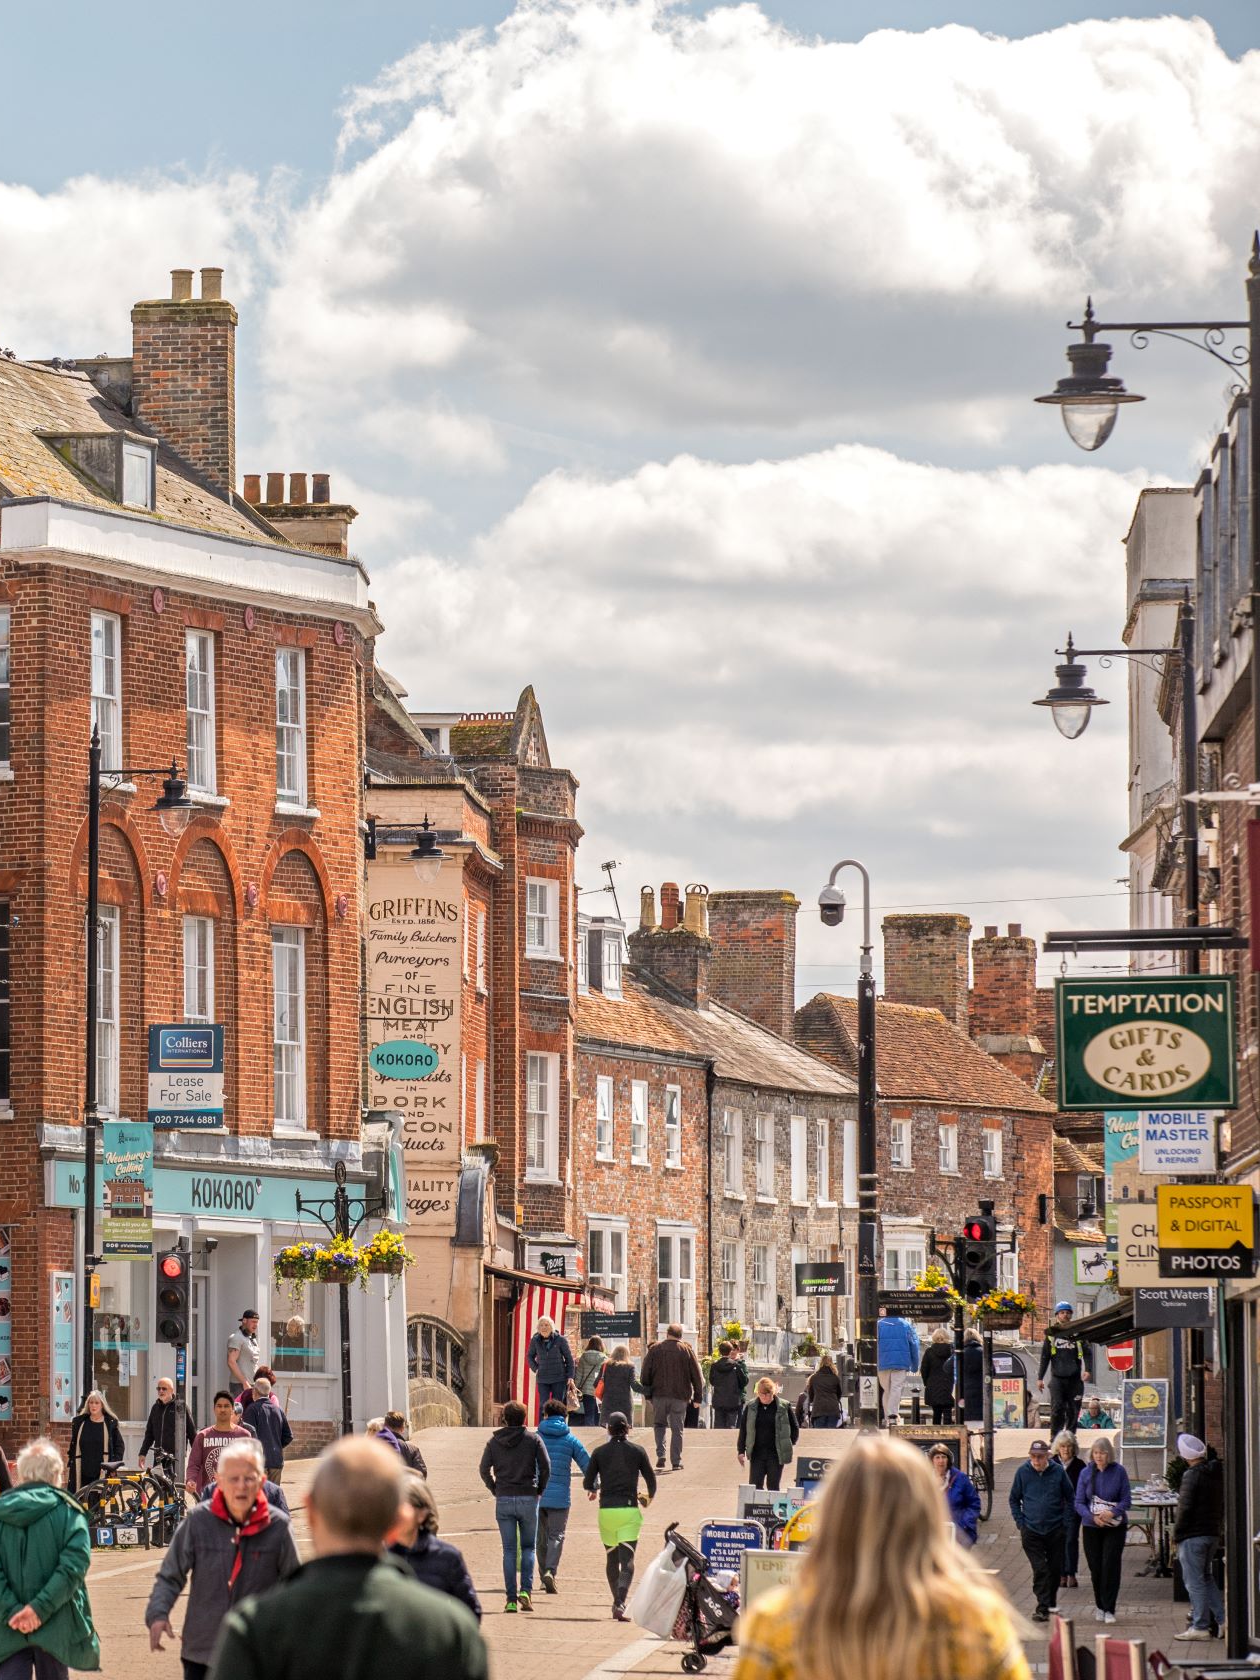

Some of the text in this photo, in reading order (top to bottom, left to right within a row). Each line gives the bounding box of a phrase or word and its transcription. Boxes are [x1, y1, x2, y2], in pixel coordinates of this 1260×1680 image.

[369, 898, 458, 921] GRIFFINS
[369, 930, 457, 944] Family Butchers
[375, 951, 450, 968] Purveyors
[404, 972, 419, 980] OF
[385, 984, 437, 994] FINE
[370, 997, 454, 1016] ENGLISH
[1067, 993, 1224, 1015] TEMPTATION
[386, 1020, 439, 1032] MEAT
[165, 1036, 208, 1048] Colliers
[1108, 1027, 1183, 1050] GIFTS
[376, 1053, 433, 1066] KOKORO
[1135, 1048, 1156, 1067] &
[168, 1075, 204, 1087] Lease
[1103, 1064, 1191, 1091] CARDS
[160, 1089, 212, 1101] For Sale
[373, 1095, 447, 1109] PORK
[155, 1115, 216, 1124] 020 7344 6881
[1148, 1113, 1207, 1125] MOBILE
[403, 1121, 453, 1134] CON
[1146, 1129, 1209, 1141] MASTER
[403, 1137, 446, 1151] ducts
[105, 1151, 151, 1165] Newbury's
[68, 1174, 81, 1194] No
[191, 1177, 256, 1211] KOKORO
[1169, 1196, 1242, 1209] PASSPORT
[1170, 1220, 1181, 1232] &
[1185, 1219, 1242, 1232] DIGITAL
[1171, 1255, 1241, 1270] PHOTOS
[818, 1285, 836, 1293] HERE
[1139, 1288, 1209, 1300] Scott Waters
[1001, 1380, 1020, 1392] BIG
[1134, 1393, 1141, 1404] 3
[1149, 1393, 1157, 1404] 2
[203, 1437, 236, 1448] RAMO
[101, 1530, 111, 1543] P
[706, 1530, 755, 1540] MOBILE MASTER
